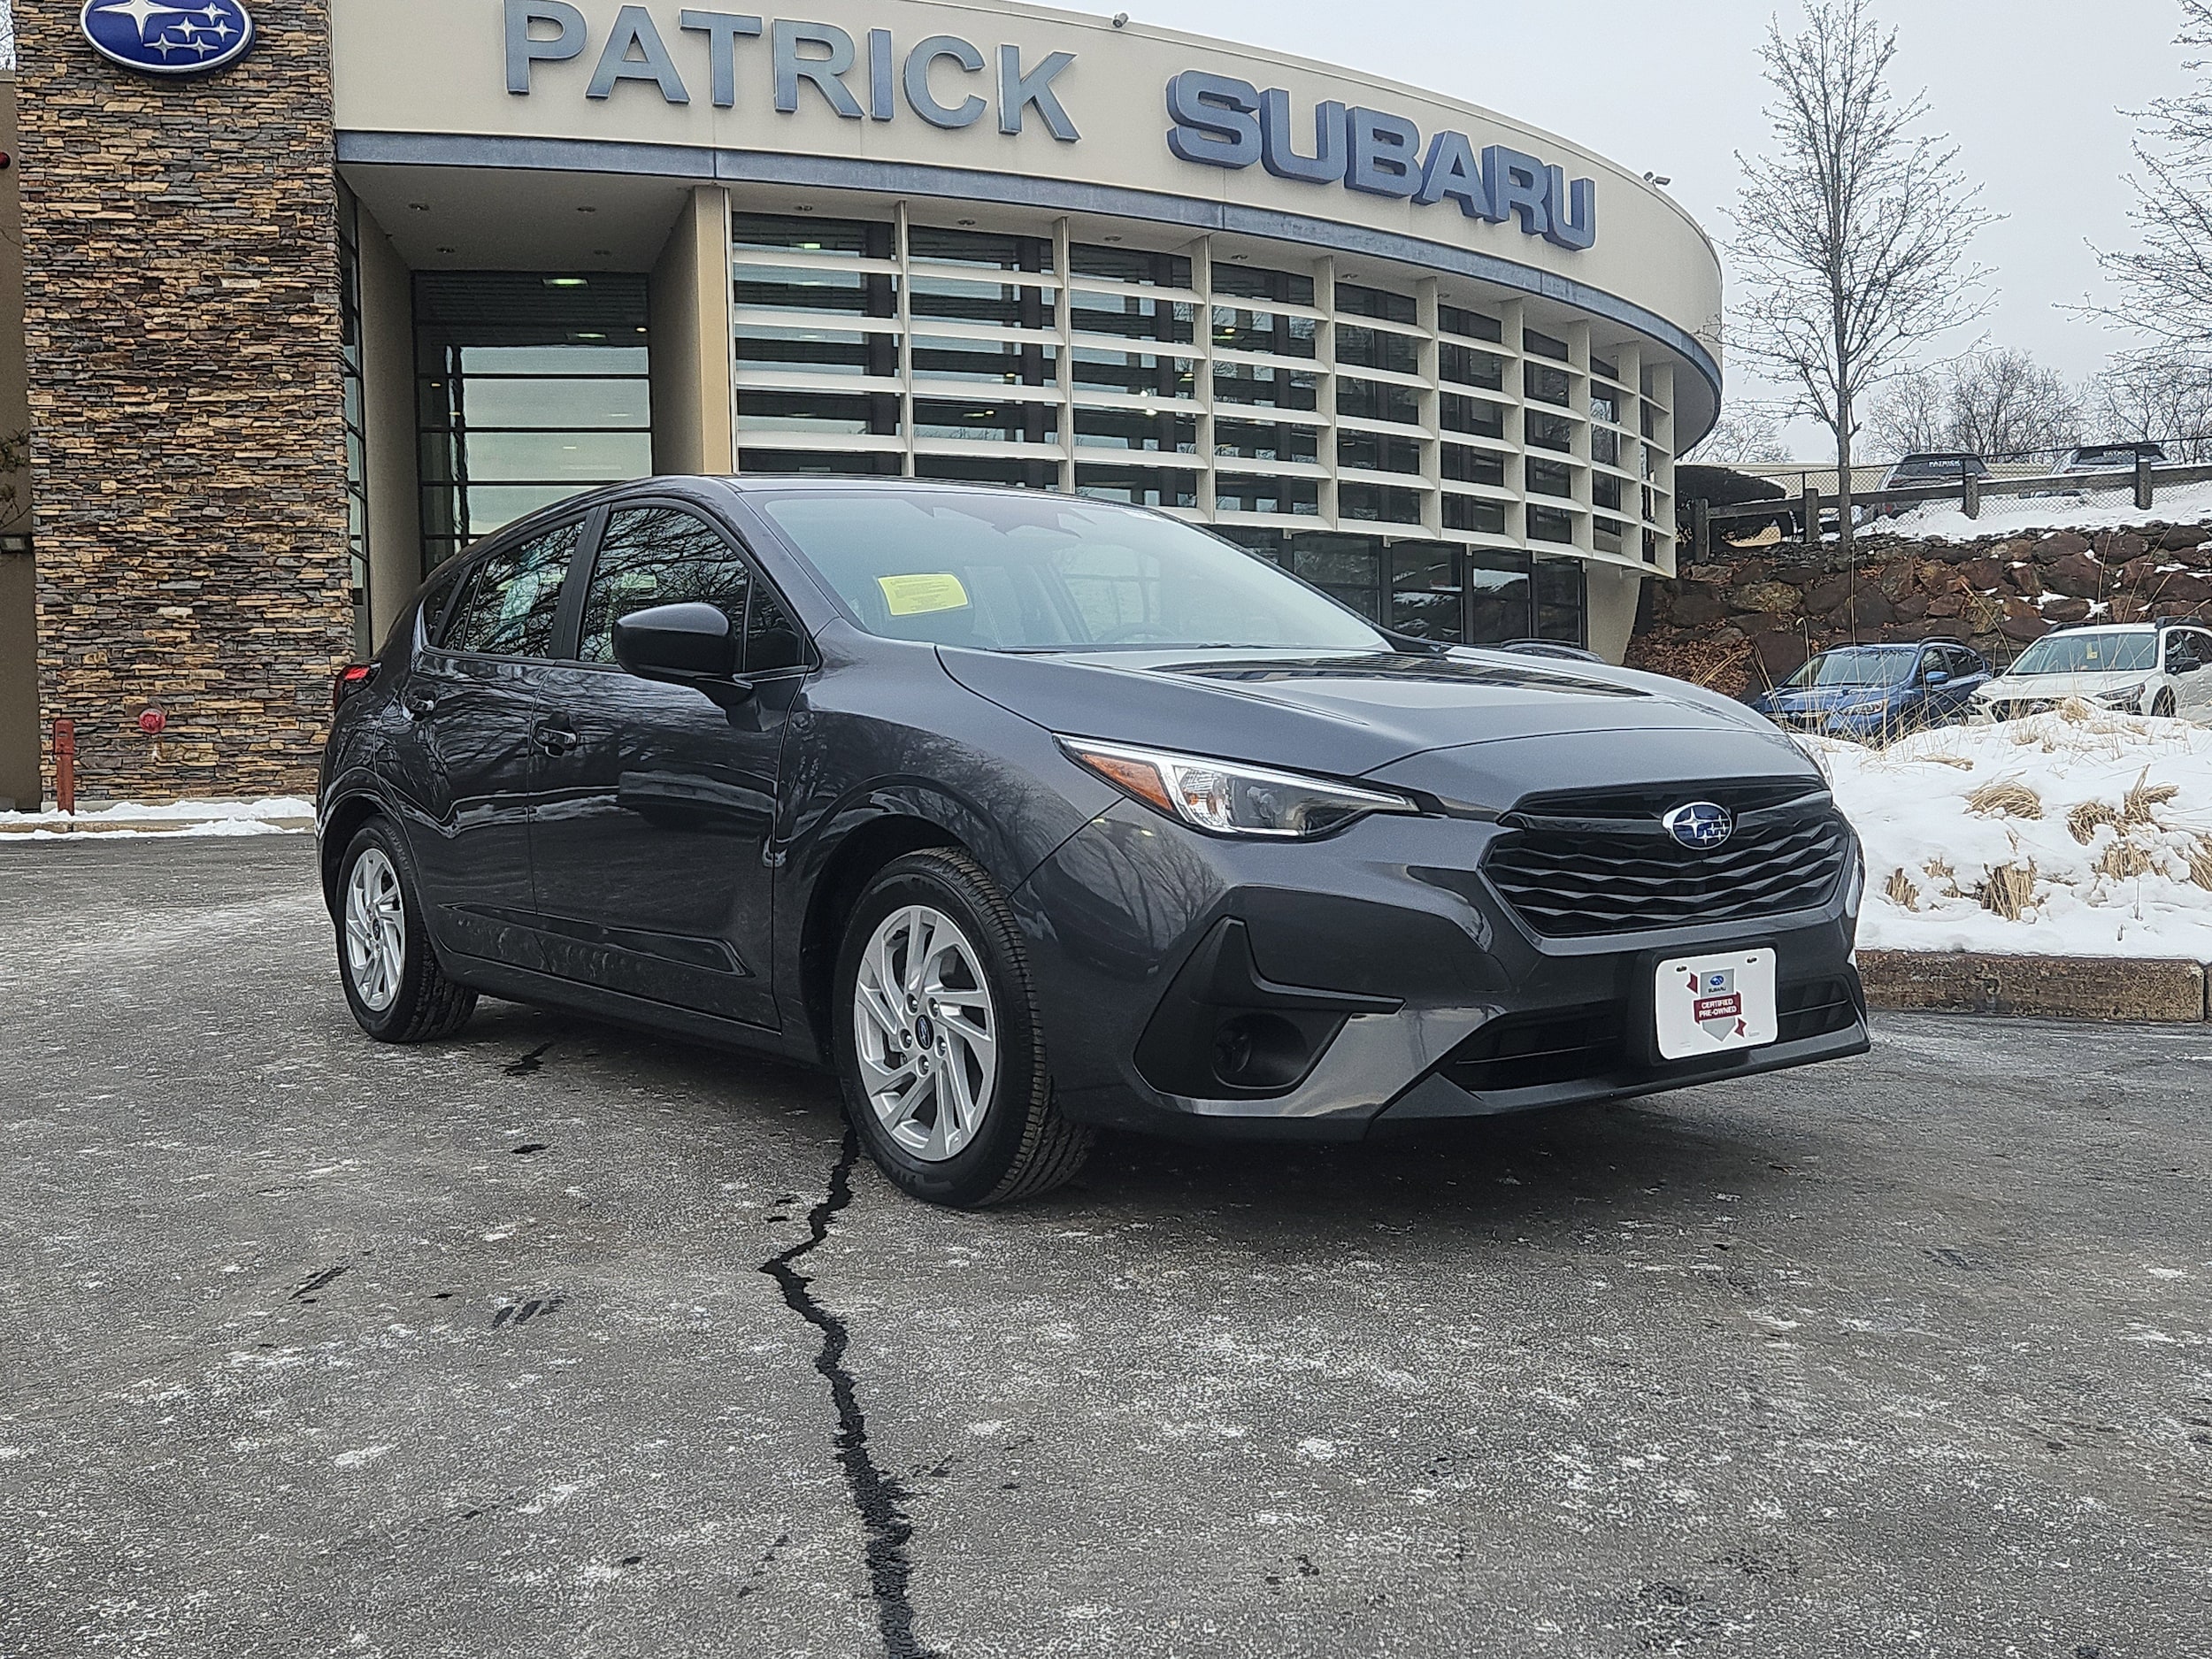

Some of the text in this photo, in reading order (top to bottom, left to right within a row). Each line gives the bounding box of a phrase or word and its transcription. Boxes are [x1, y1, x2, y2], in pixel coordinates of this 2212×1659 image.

[503, 0, 1596, 251] PATRICK SUBARU
[1701, 998, 1733, 1009] CERTIFIED
[1699, 1005, 1737, 1018] PRE-OWNED
